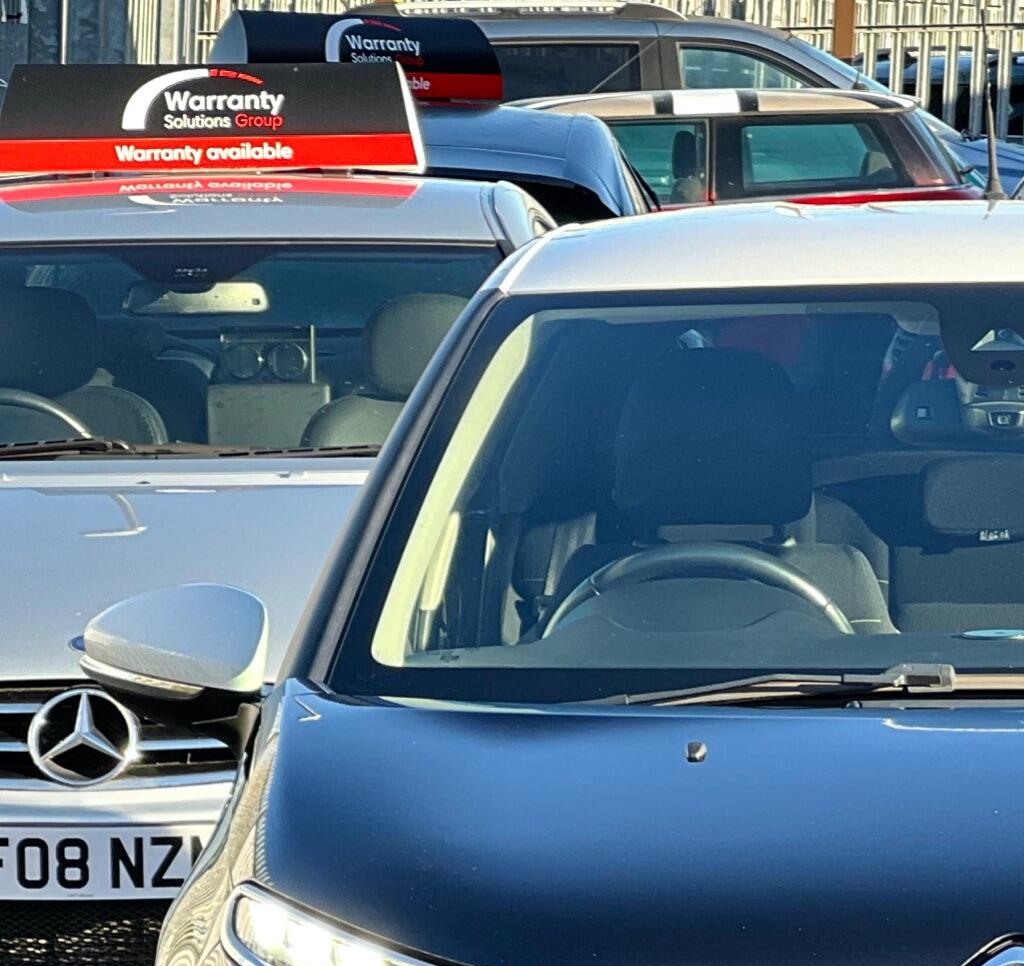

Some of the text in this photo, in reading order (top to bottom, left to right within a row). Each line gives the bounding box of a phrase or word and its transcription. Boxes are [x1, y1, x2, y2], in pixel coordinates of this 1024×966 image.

[345, 34, 421, 56] Warranty
[164, 90, 285, 116] Warranty
[163, 113, 283, 131] Solutions Group
[115, 141, 294, 165] Warranty available
